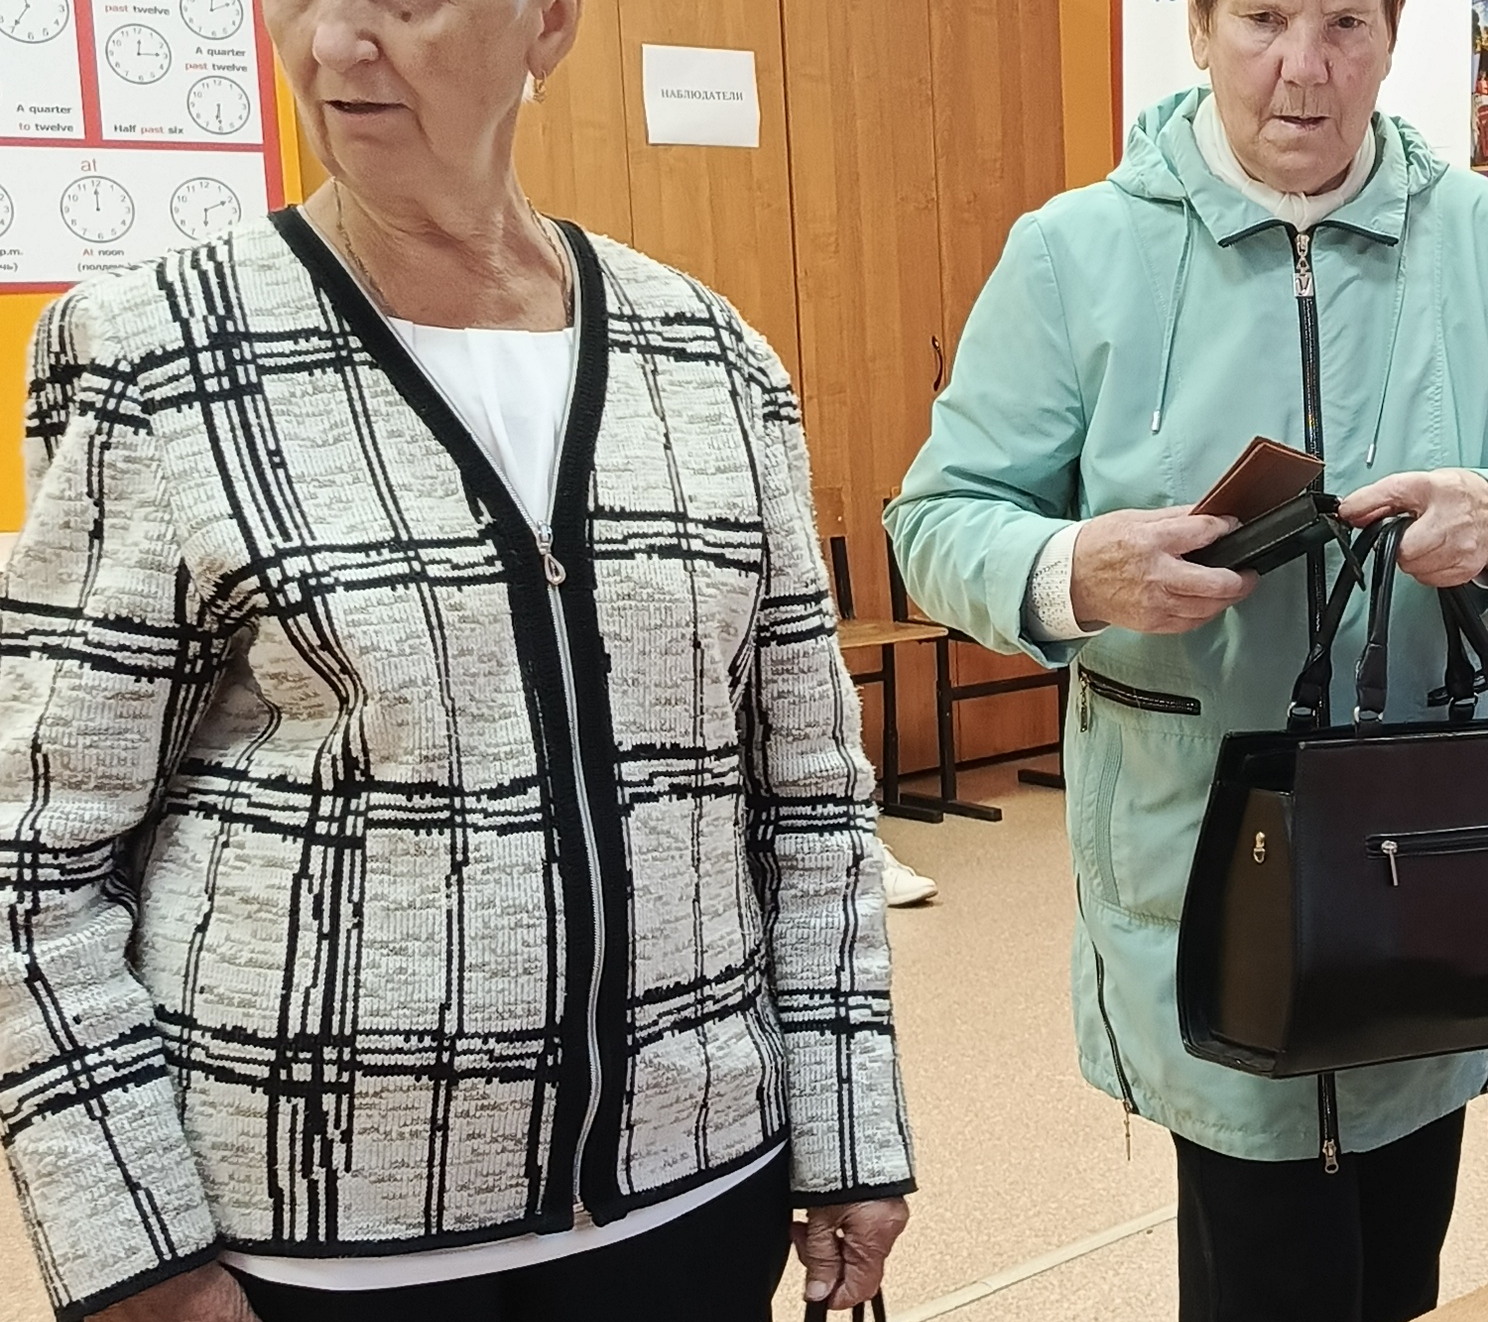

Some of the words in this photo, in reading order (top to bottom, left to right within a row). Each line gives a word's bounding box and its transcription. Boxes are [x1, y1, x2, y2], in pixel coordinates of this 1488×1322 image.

[59, 5, 65, 13] 3
[105, 5, 129, 13] past
[133, 5, 170, 15] twelve
[196, 46, 203, 55] A
[207, 47, 246, 57] quarter
[185, 62, 208, 71] past
[212, 63, 248, 72] twelve
[661, 89, 743, 101] НАБЛЮДАТЕЛИ
[16, 104, 24, 113] A
[29, 105, 72, 114] quarter
[19, 123, 30, 131] to
[35, 123, 74, 132] twelve
[114, 125, 136, 133] Half
[141, 125, 164, 135] past
[168, 126, 184, 135] six
[80, 158, 97, 172] at
[200, 181, 210, 189] 12
[177, 195, 187, 203] 10
